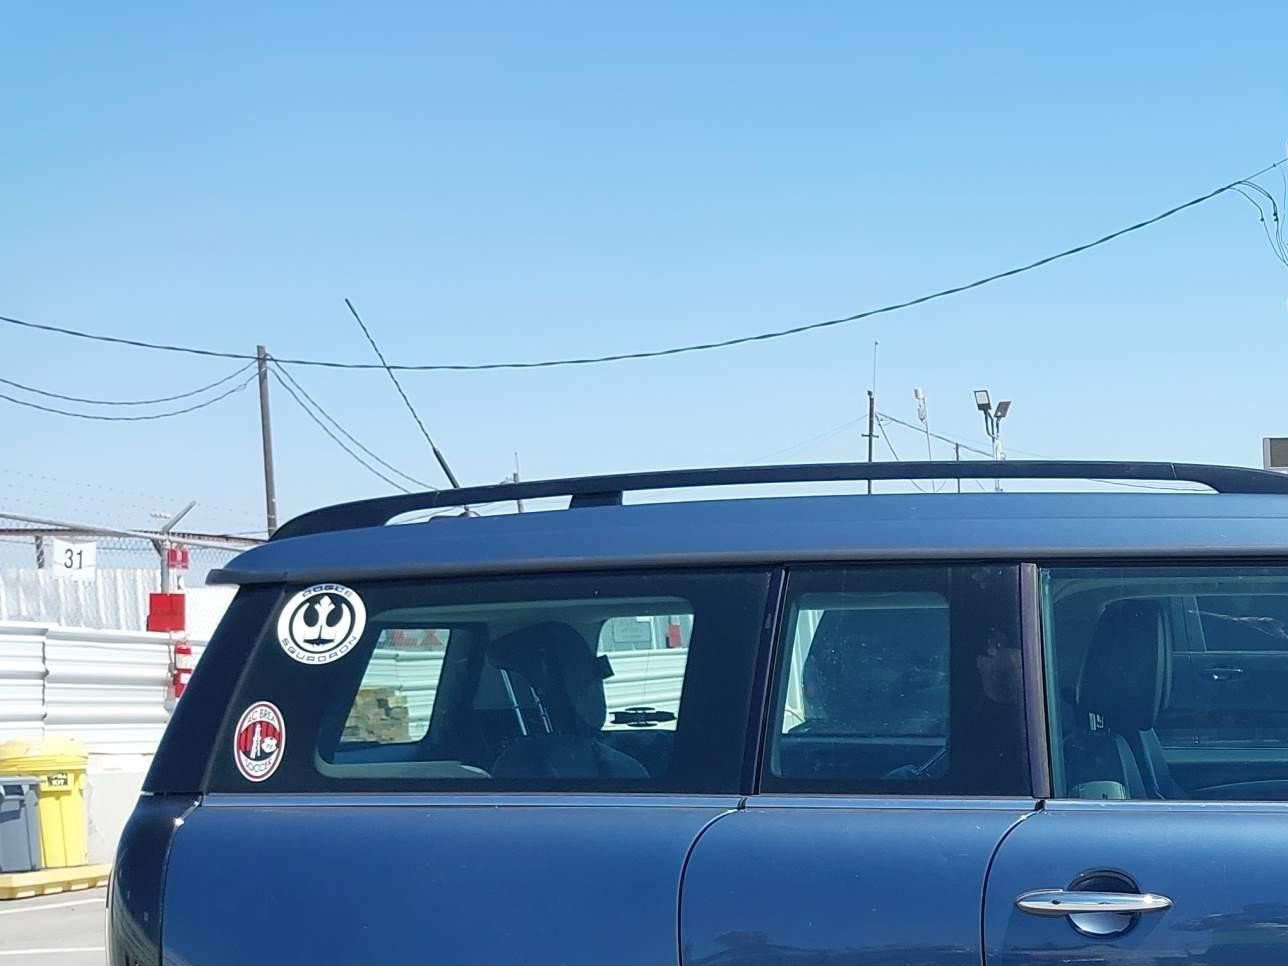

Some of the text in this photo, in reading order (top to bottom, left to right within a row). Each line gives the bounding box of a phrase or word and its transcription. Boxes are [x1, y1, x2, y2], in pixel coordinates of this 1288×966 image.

[63, 548, 83, 570] 31
[302, 584, 354, 598] ROGUE
[282, 635, 357, 662] SQUADRON
